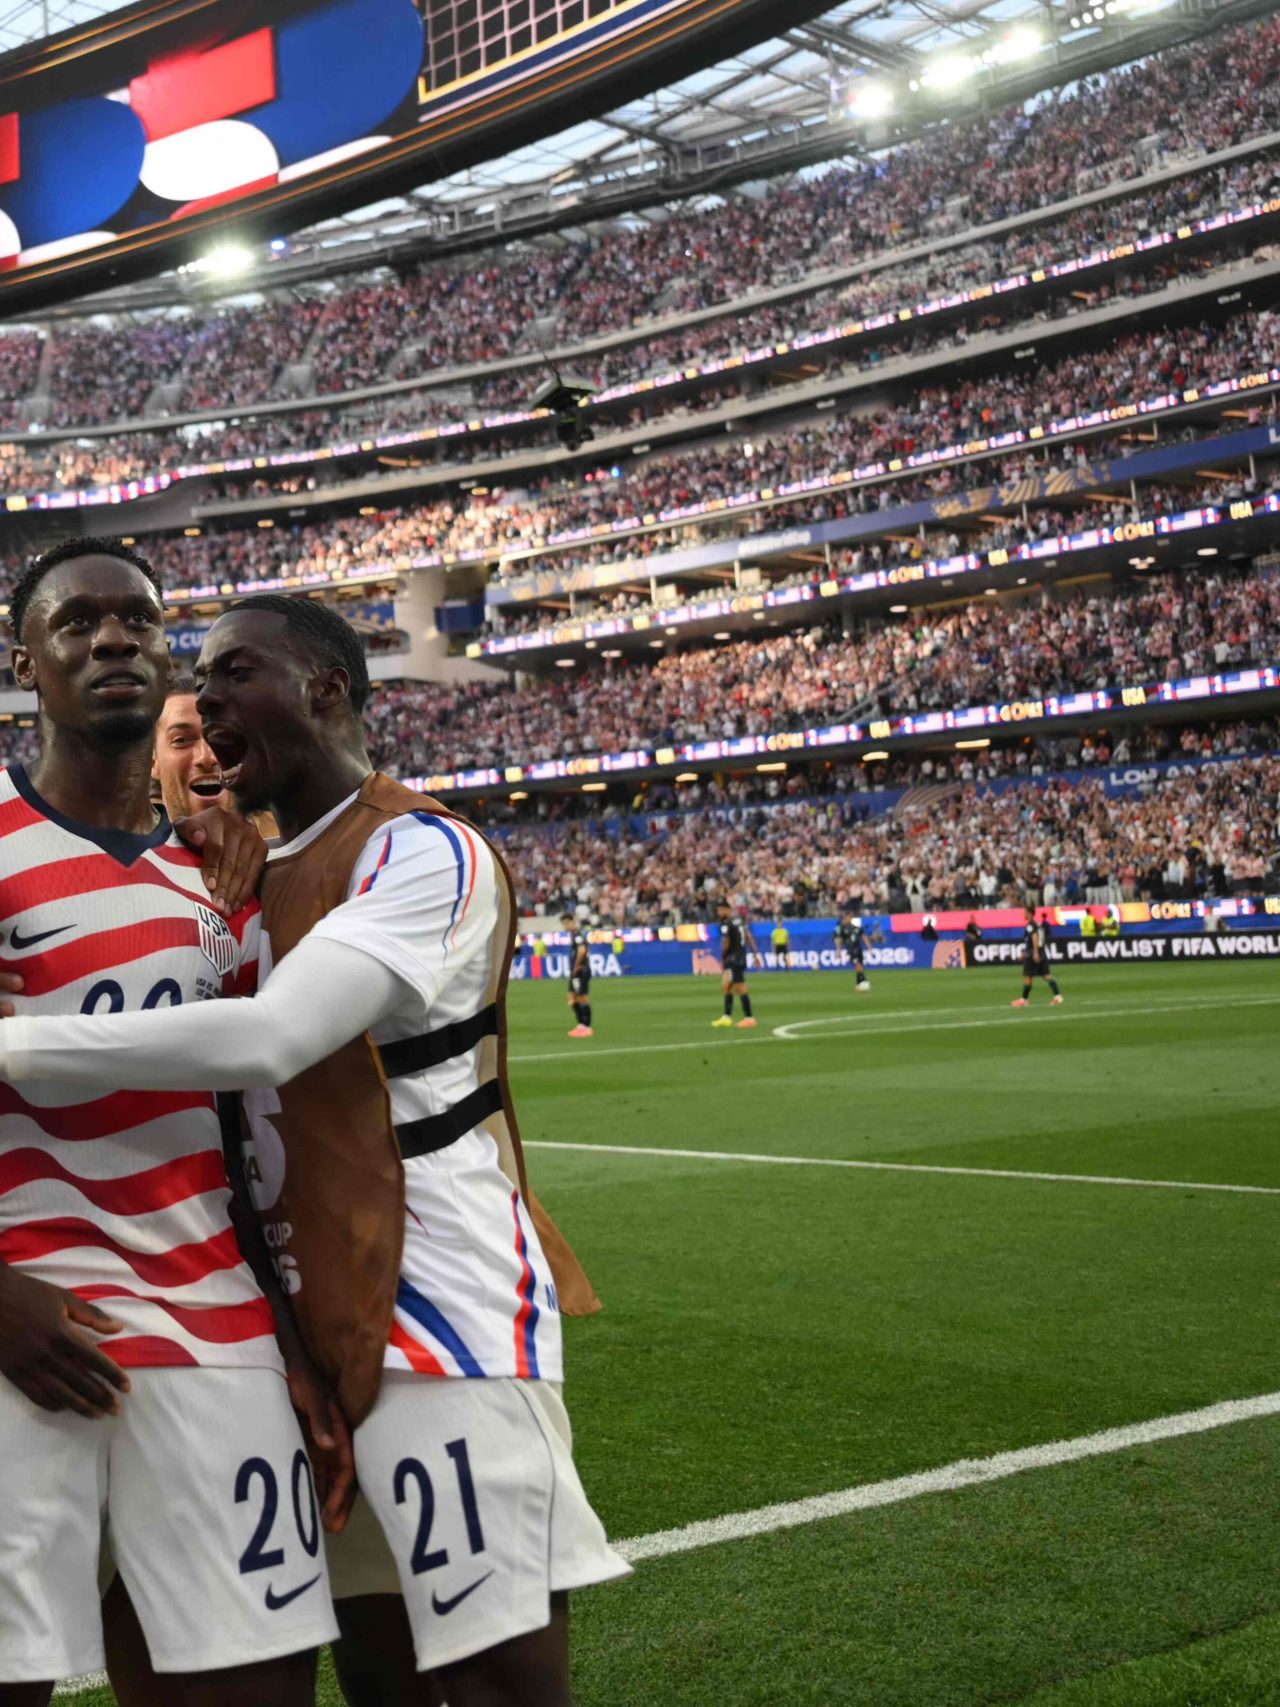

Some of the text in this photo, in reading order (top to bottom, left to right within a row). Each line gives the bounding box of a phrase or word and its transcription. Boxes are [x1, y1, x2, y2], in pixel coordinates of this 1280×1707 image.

[1230, 500, 1253, 520] USA
[179, 631, 206, 650] CU
[198, 905, 230, 937] USA
[1067, 938, 1167, 960] PLAYLIST
[1171, 936, 1216, 957] FIFA
[1216, 934, 1280, 955] WORL
[545, 953, 622, 977] ULRA
[263, 1221, 293, 1248] CUP
[234, 1447, 319, 1576] 20
[393, 1437, 485, 1576] 21
